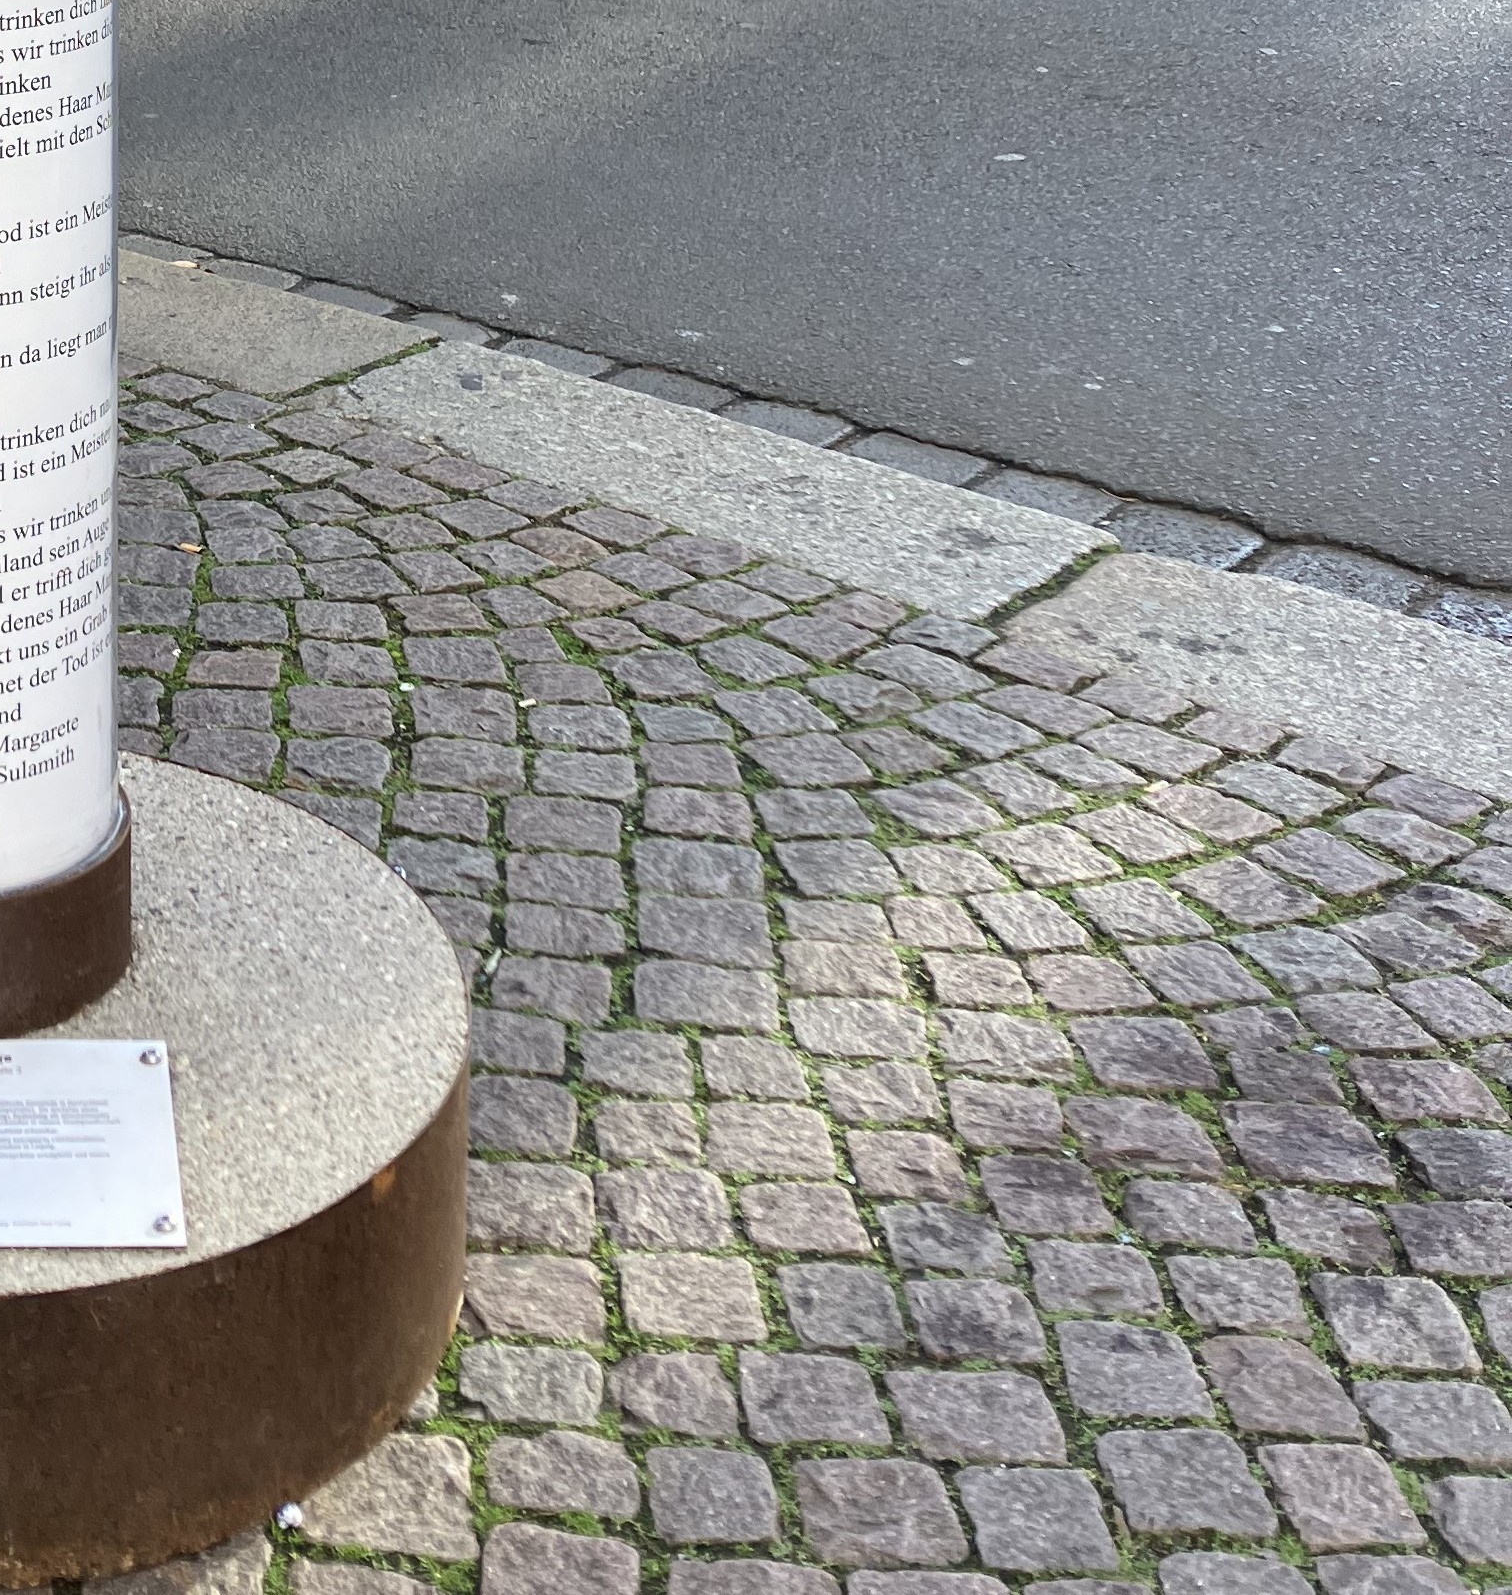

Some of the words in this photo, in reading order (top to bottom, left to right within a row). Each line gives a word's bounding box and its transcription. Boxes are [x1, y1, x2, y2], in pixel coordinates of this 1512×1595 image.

[28, 219, 50, 239] ist
[55, 211, 78, 233] ein
[11, 459, 35, 480] ist
[41, 451, 66, 474] ein
[49, 534, 80, 565] sein
[17, 638, 49, 660] uns
[55, 627, 78, 649] ein
